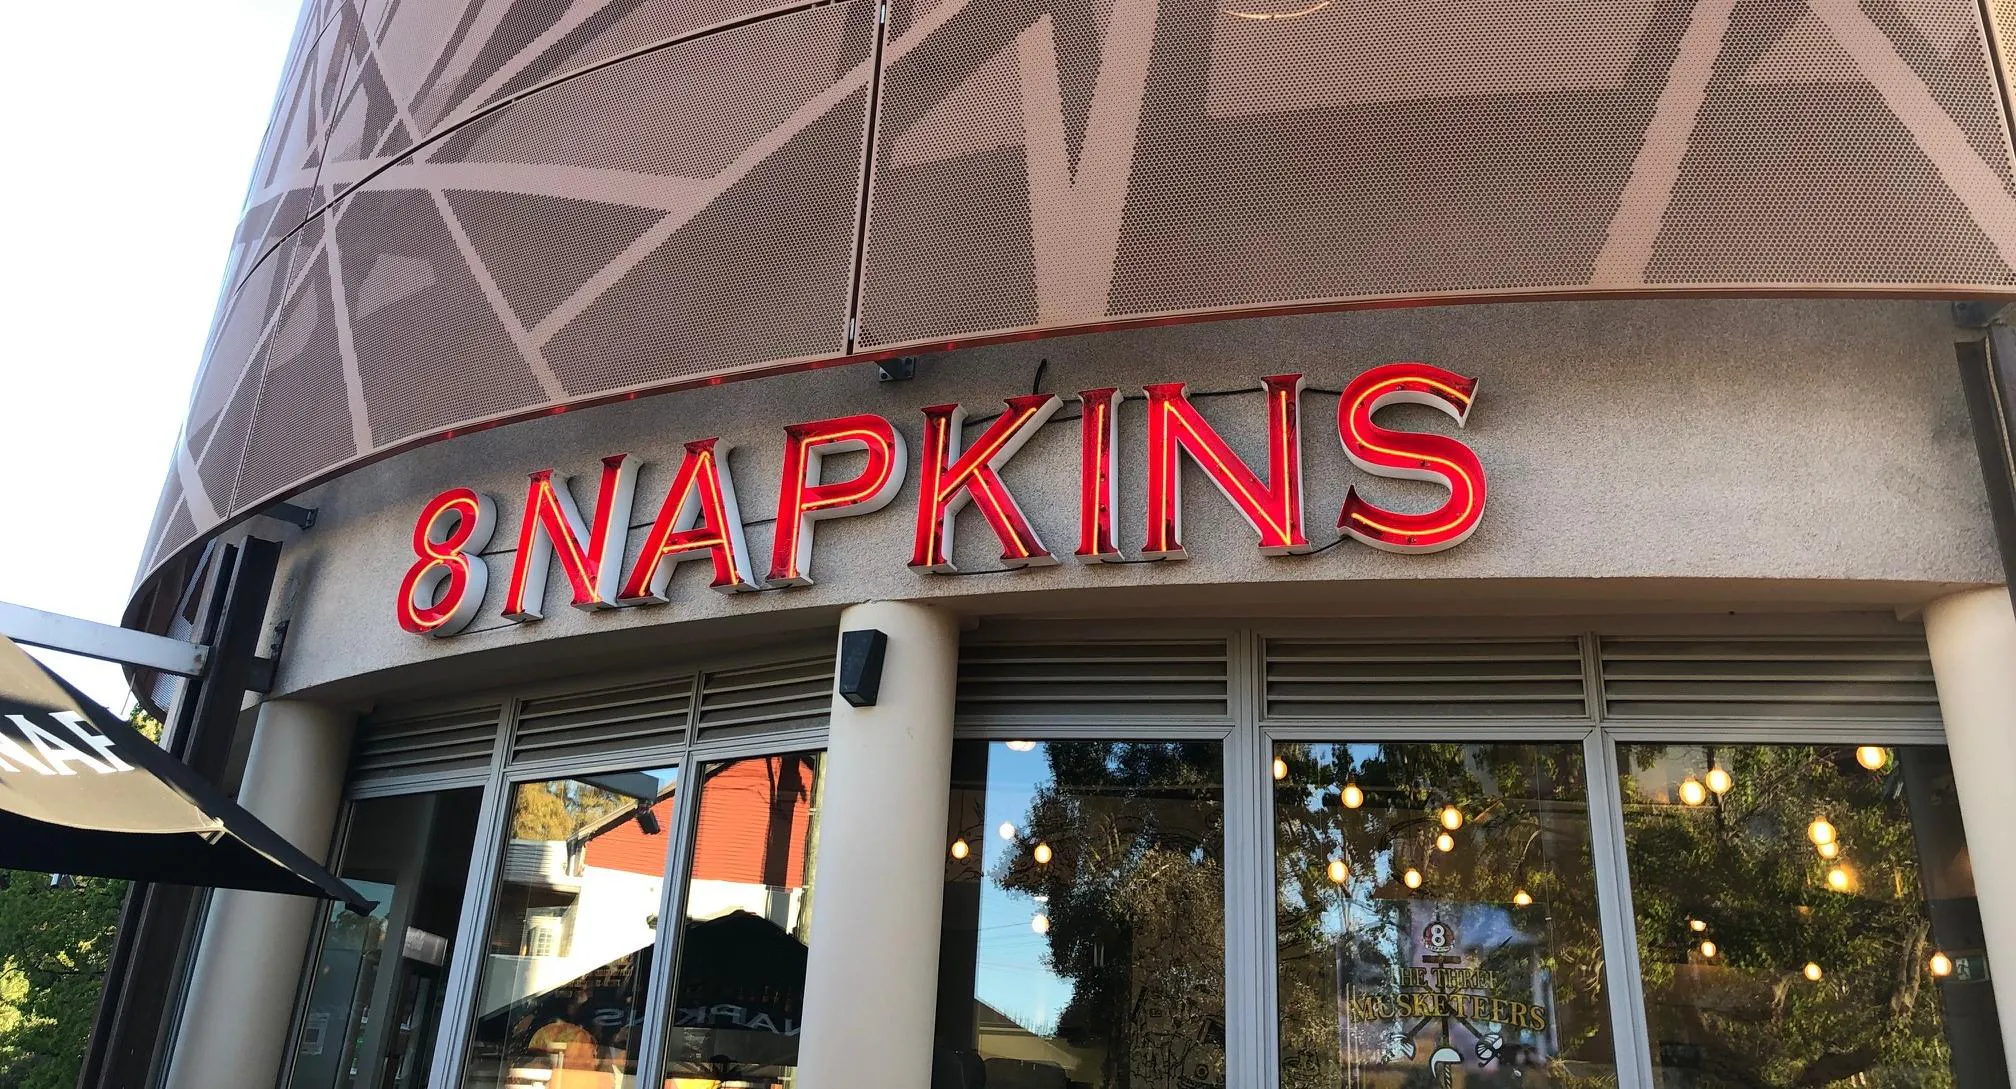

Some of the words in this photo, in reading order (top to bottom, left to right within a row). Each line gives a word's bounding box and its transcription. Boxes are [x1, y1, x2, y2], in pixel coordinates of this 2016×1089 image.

[397, 487, 497, 637] 8
[501, 362, 1487, 622] NAPKINS
[1430, 923, 1447, 947] 8
[1348, 992, 1547, 1031] MUSKETEERS
